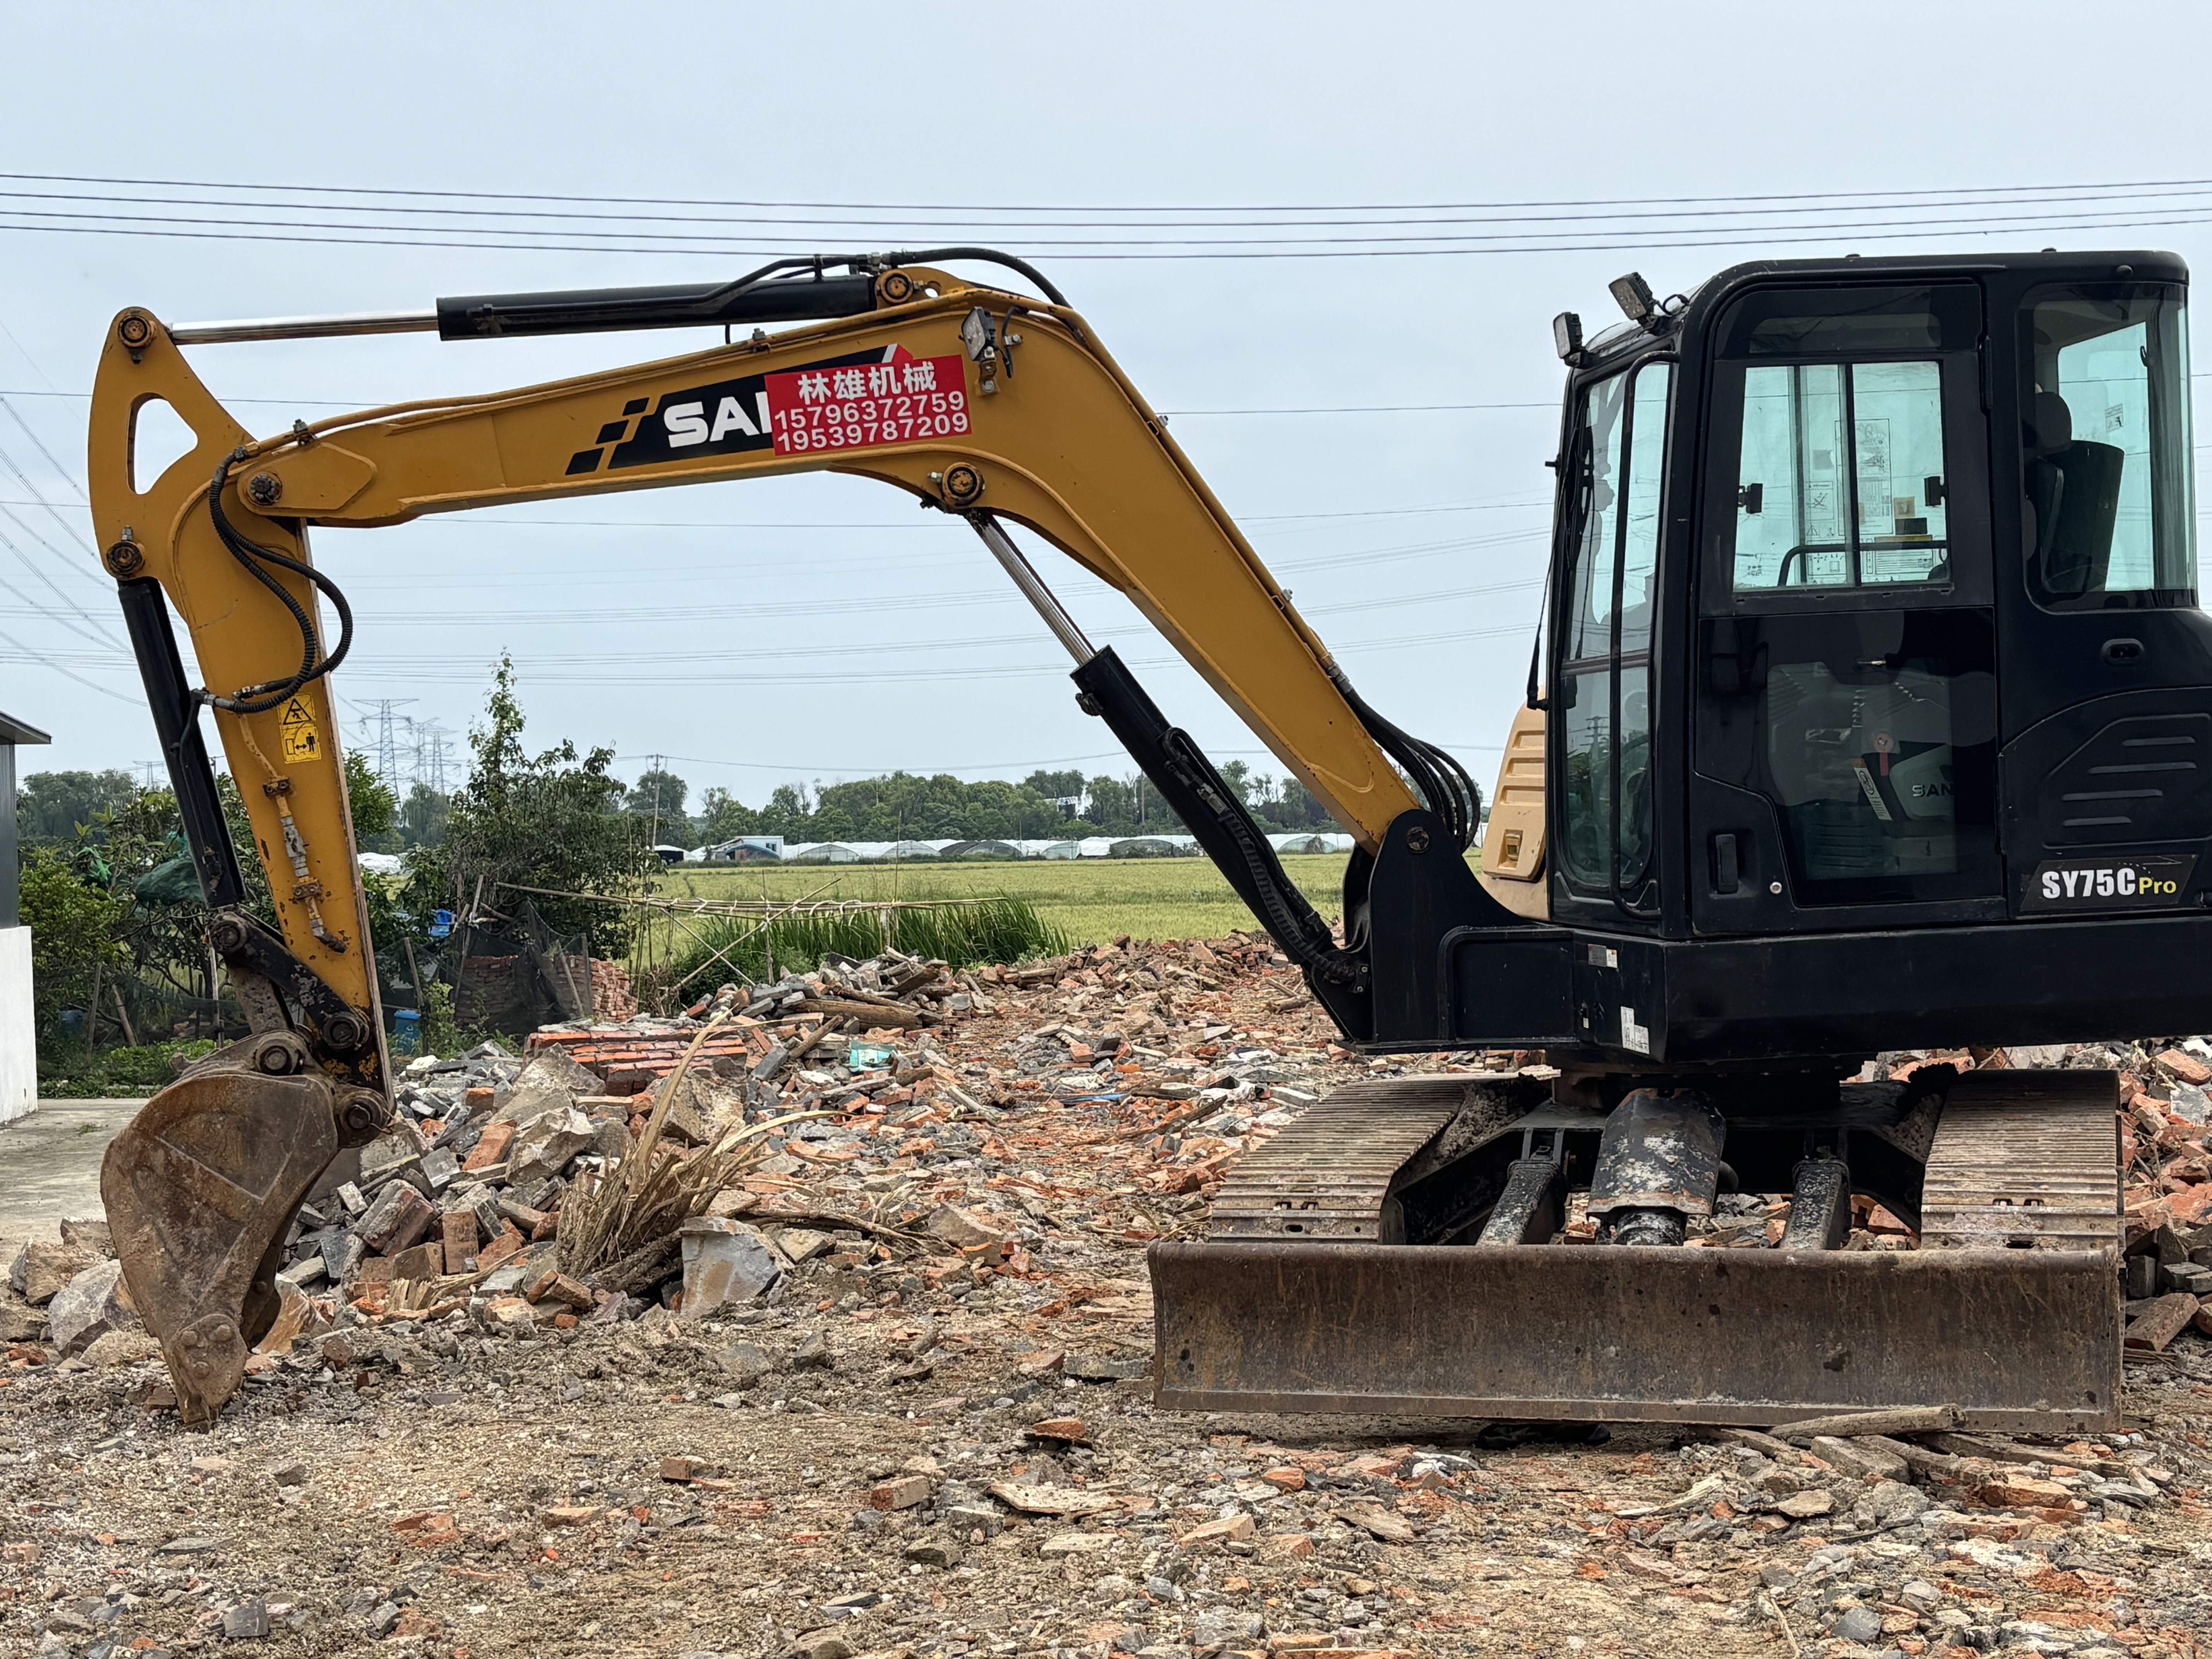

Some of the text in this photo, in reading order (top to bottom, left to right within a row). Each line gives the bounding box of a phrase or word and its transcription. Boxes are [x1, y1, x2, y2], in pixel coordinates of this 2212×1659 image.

[798, 361, 937, 405] 林雄机械
[775, 390, 965, 430] 15796372759
[777, 412, 968, 452] 19539787209
[2042, 867, 2177, 899] SY75C Pro
